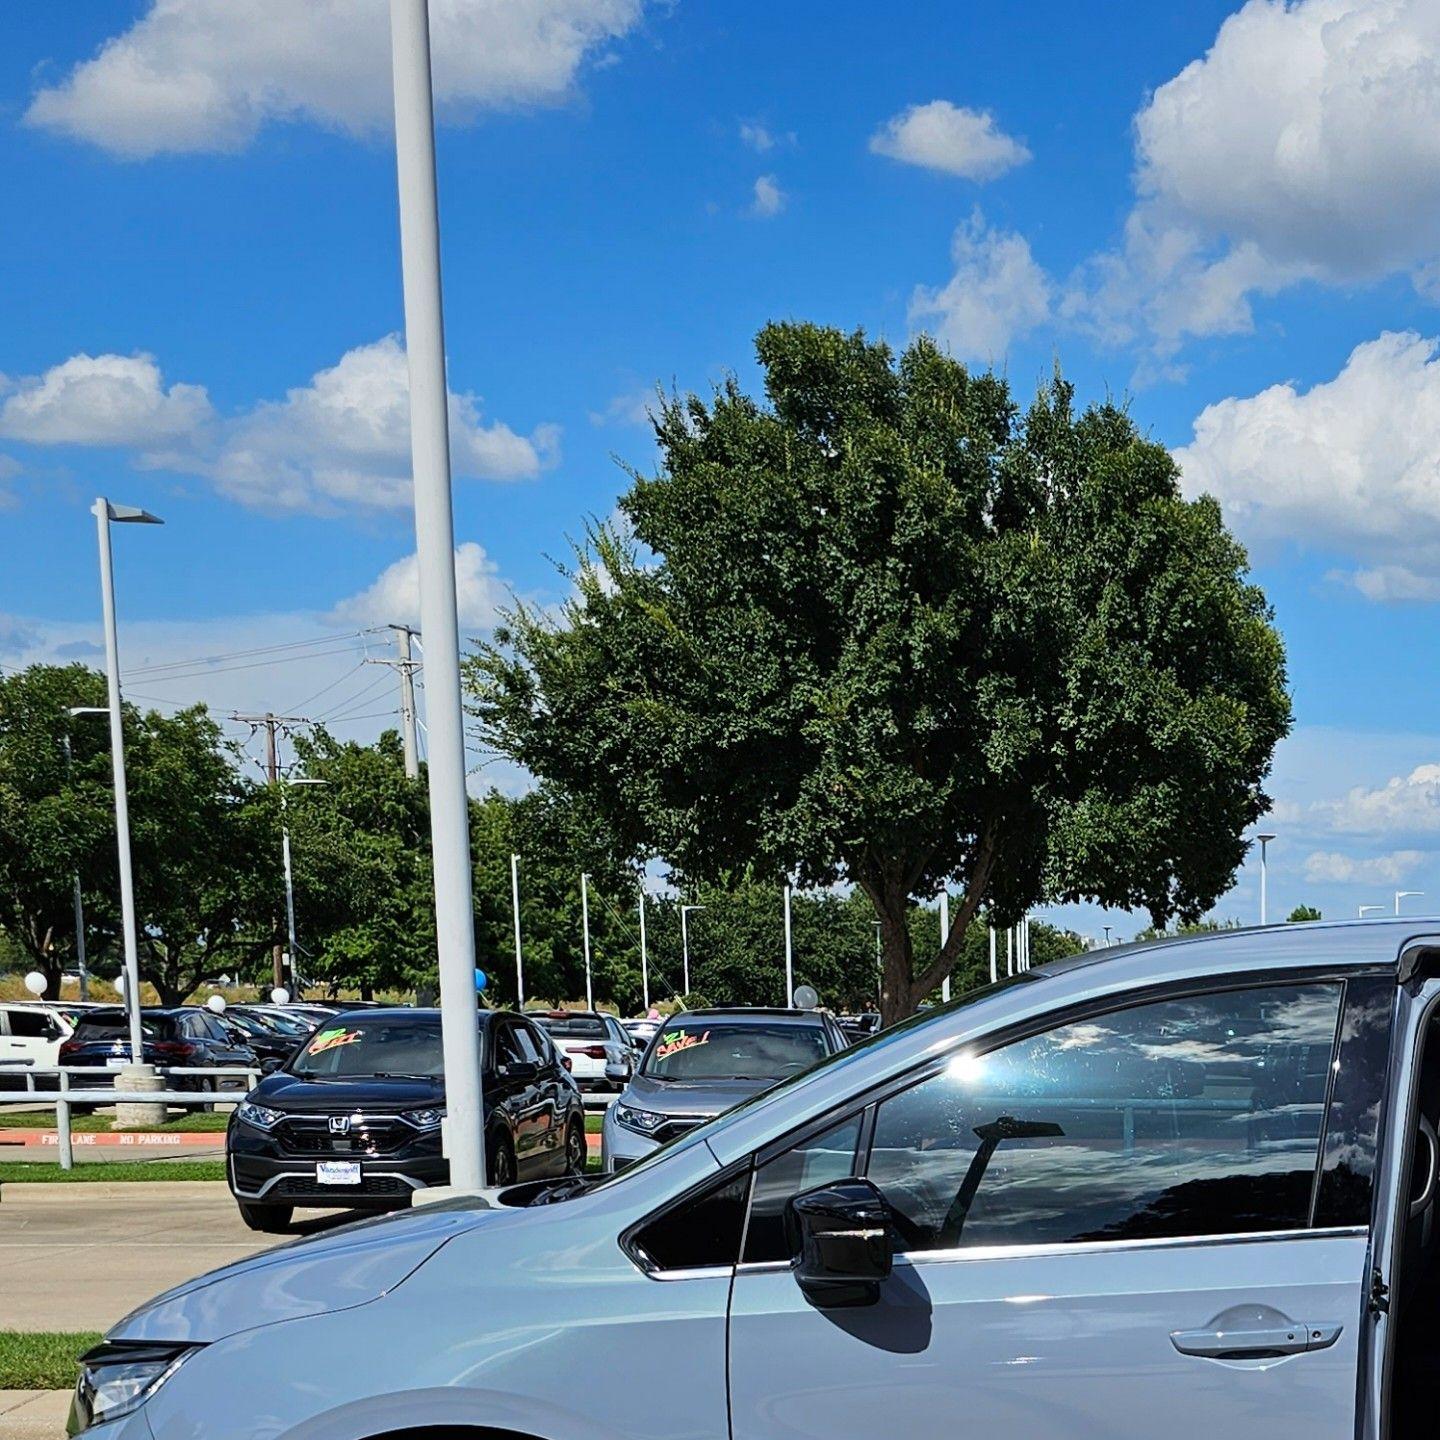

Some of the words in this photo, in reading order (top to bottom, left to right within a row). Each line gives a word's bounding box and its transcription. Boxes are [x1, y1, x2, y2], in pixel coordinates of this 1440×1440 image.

[70, 1134, 97, 1145] LANE
[119, 1134, 134, 1145] NO
[137, 1134, 181, 1145] PARKING
